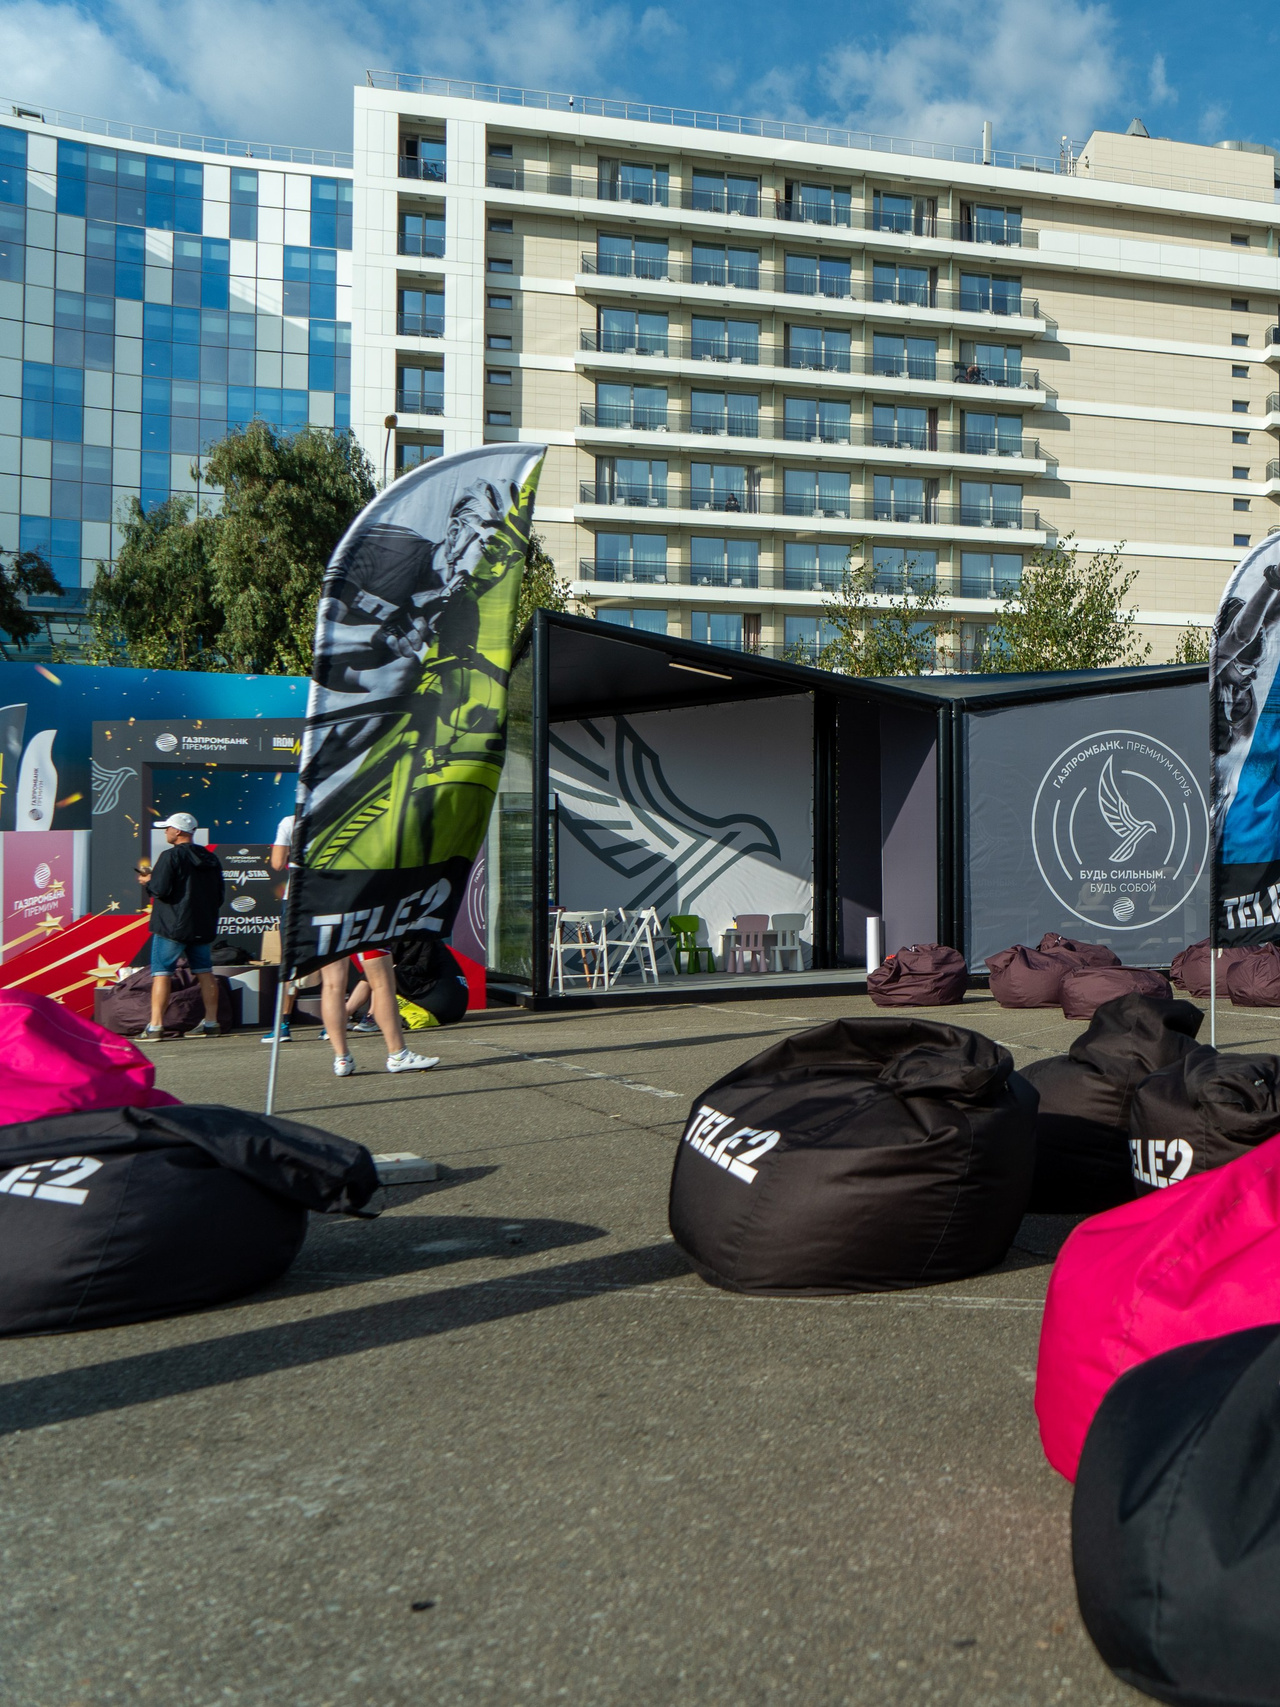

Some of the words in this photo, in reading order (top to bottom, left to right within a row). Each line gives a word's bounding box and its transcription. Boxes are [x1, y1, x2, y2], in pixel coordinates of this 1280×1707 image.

[182, 736, 248, 745] ГАЗПРОМБАНК
[272, 737, 294, 747] IRON
[1053, 740, 1124, 788] ГАЗПРОМБАНК.
[1126, 741, 1174, 772] ПРЕМИУМ
[1171, 769, 1193, 797] КЛУБ
[1080, 870, 1108, 881] БУДЬ
[1110, 870, 1167, 880] СИЛЬНЫМ.
[1090, 882, 1117, 894] БУДЬ
[1119, 880, 1157, 893] СОБОЙ
[14, 889, 66, 911] ГАЗПРОМБАНК
[24, 900, 59, 918] ПРЕМИУМ
[217, 916, 281, 925] ПРОМБАН
[312, 877, 452, 956] TELE2
[685, 1105, 781, 1184] TELE2
[1128, 1139, 1194, 1189] ELE2
